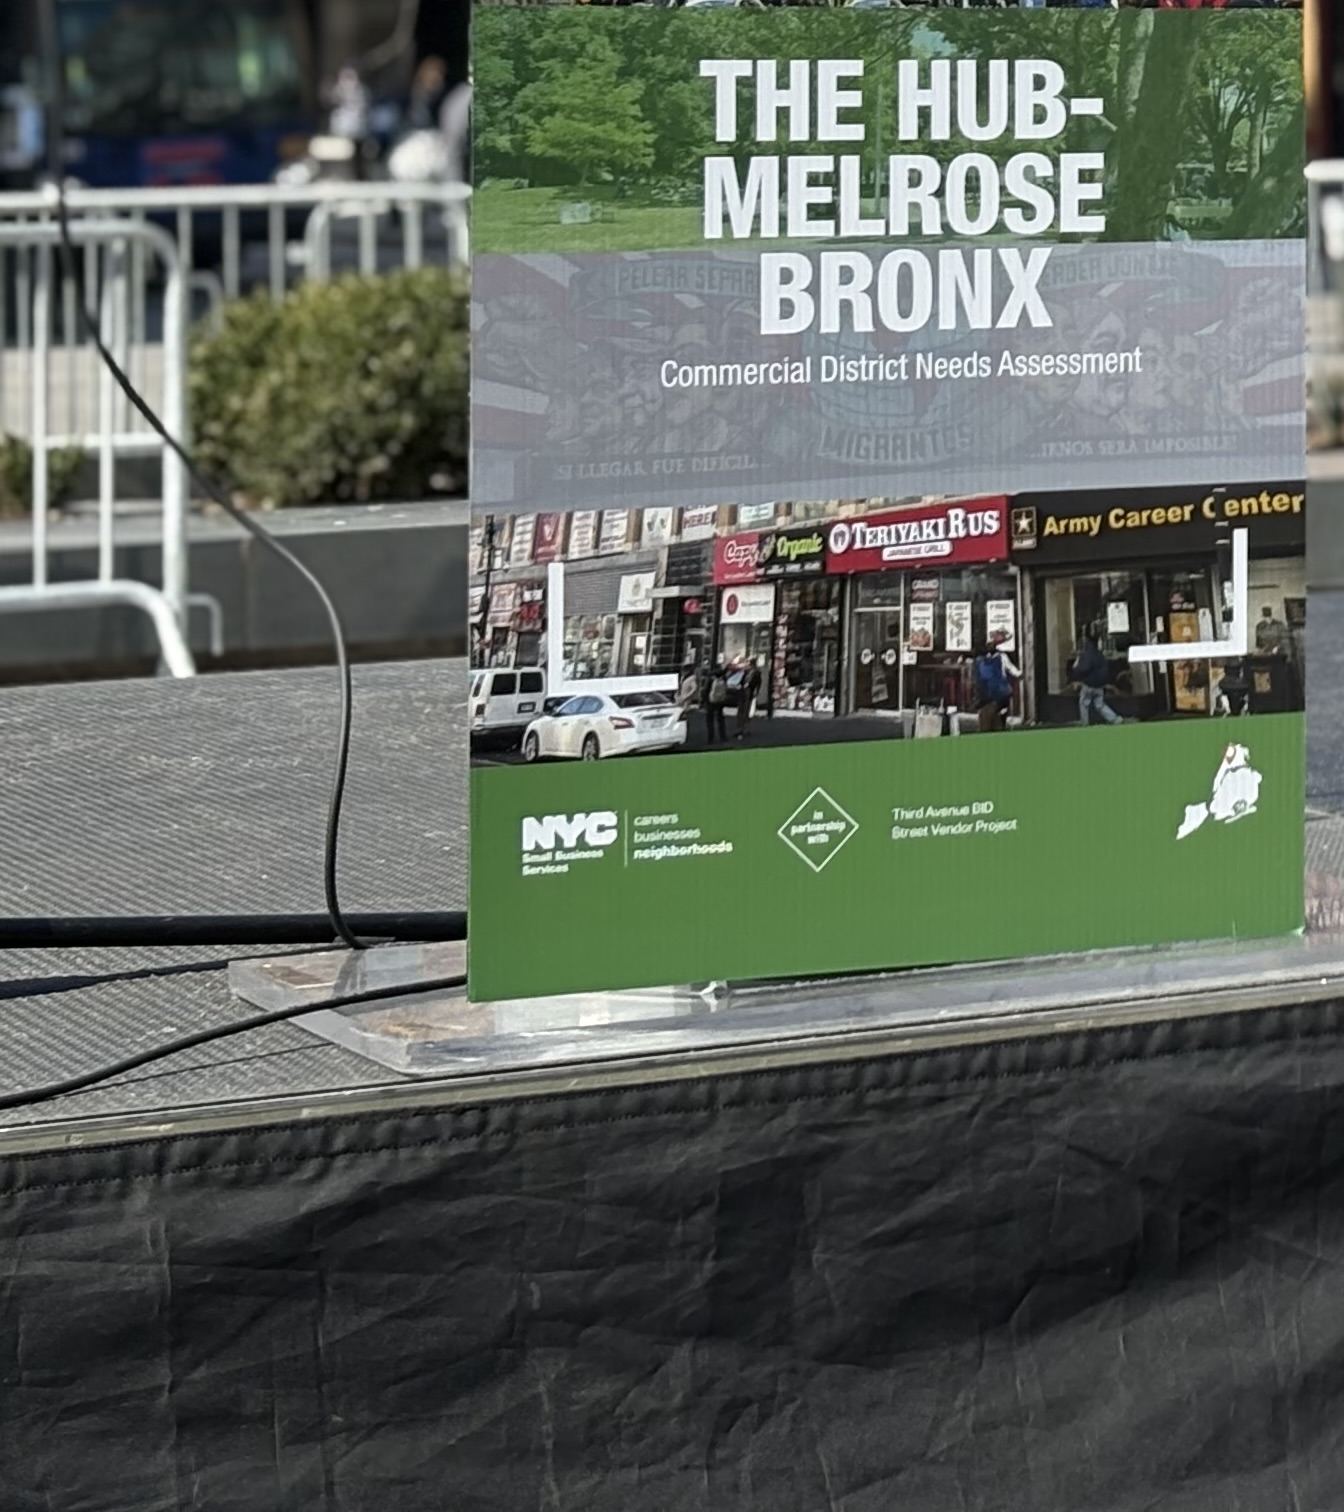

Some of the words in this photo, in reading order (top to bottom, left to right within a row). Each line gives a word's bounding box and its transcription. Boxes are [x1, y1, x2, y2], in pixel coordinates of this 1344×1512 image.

[699, 59, 864, 143] THE
[898, 58, 1104, 142] HUB-
[703, 151, 1106, 240] MELROSE
[759, 248, 1054, 336] BRONX
[660, 356, 811, 388] Commercial
[820, 352, 909, 384] District
[916, 350, 992, 380] Needs
[997, 346, 1143, 377] Assessment
[851, 517, 948, 551] TERIYAKI
[948, 507, 1001, 539] RUS
[1043, 514, 1102, 537] Army
[1107, 504, 1196, 530] Career
[633, 813, 680, 827] careers
[892, 806, 925, 822] Third
[926, 804, 971, 819] Avenue
[972, 801, 995, 815] BID
[521, 810, 619, 852] NYC
[633, 828, 702, 844] businesses
[891, 823, 929, 840] Street
[931, 820, 974, 837] Vendor
[974, 818, 1018, 835] Project
[522, 851, 554, 864] Small
[555, 849, 605, 863] Business
[633, 840, 734, 861] neighborhoods
[522, 863, 570, 877] Services
